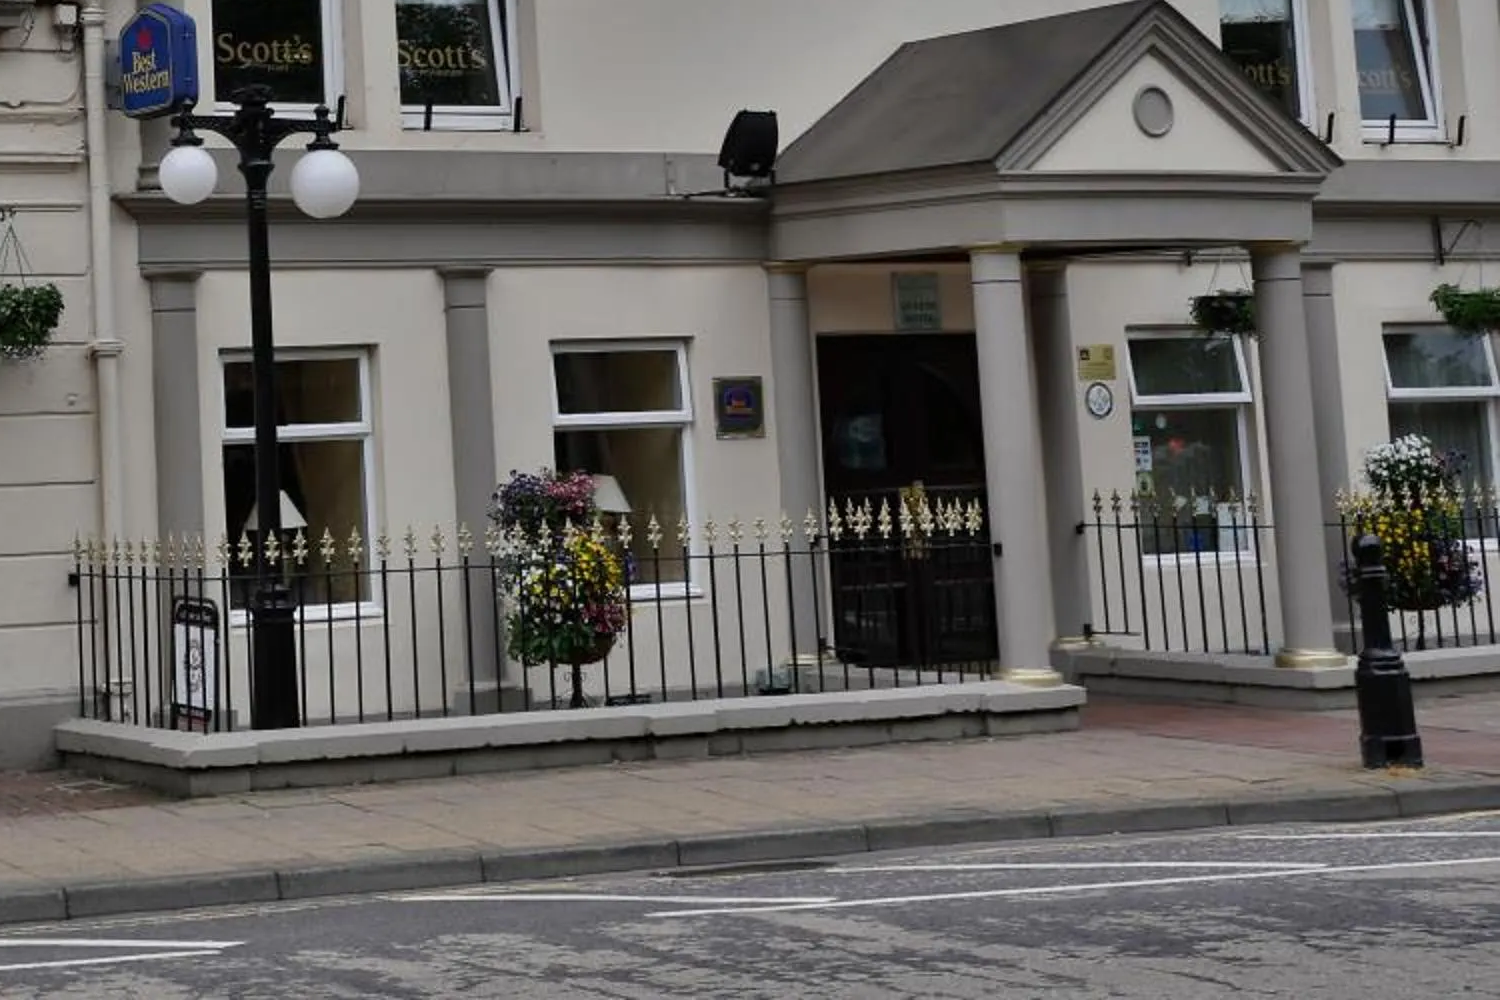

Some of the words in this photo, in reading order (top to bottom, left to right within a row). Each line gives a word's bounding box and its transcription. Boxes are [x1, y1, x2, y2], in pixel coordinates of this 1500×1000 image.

[131, 48, 157, 73] Best
[216, 32, 312, 65] Scott's
[123, 71, 169, 94] Western
